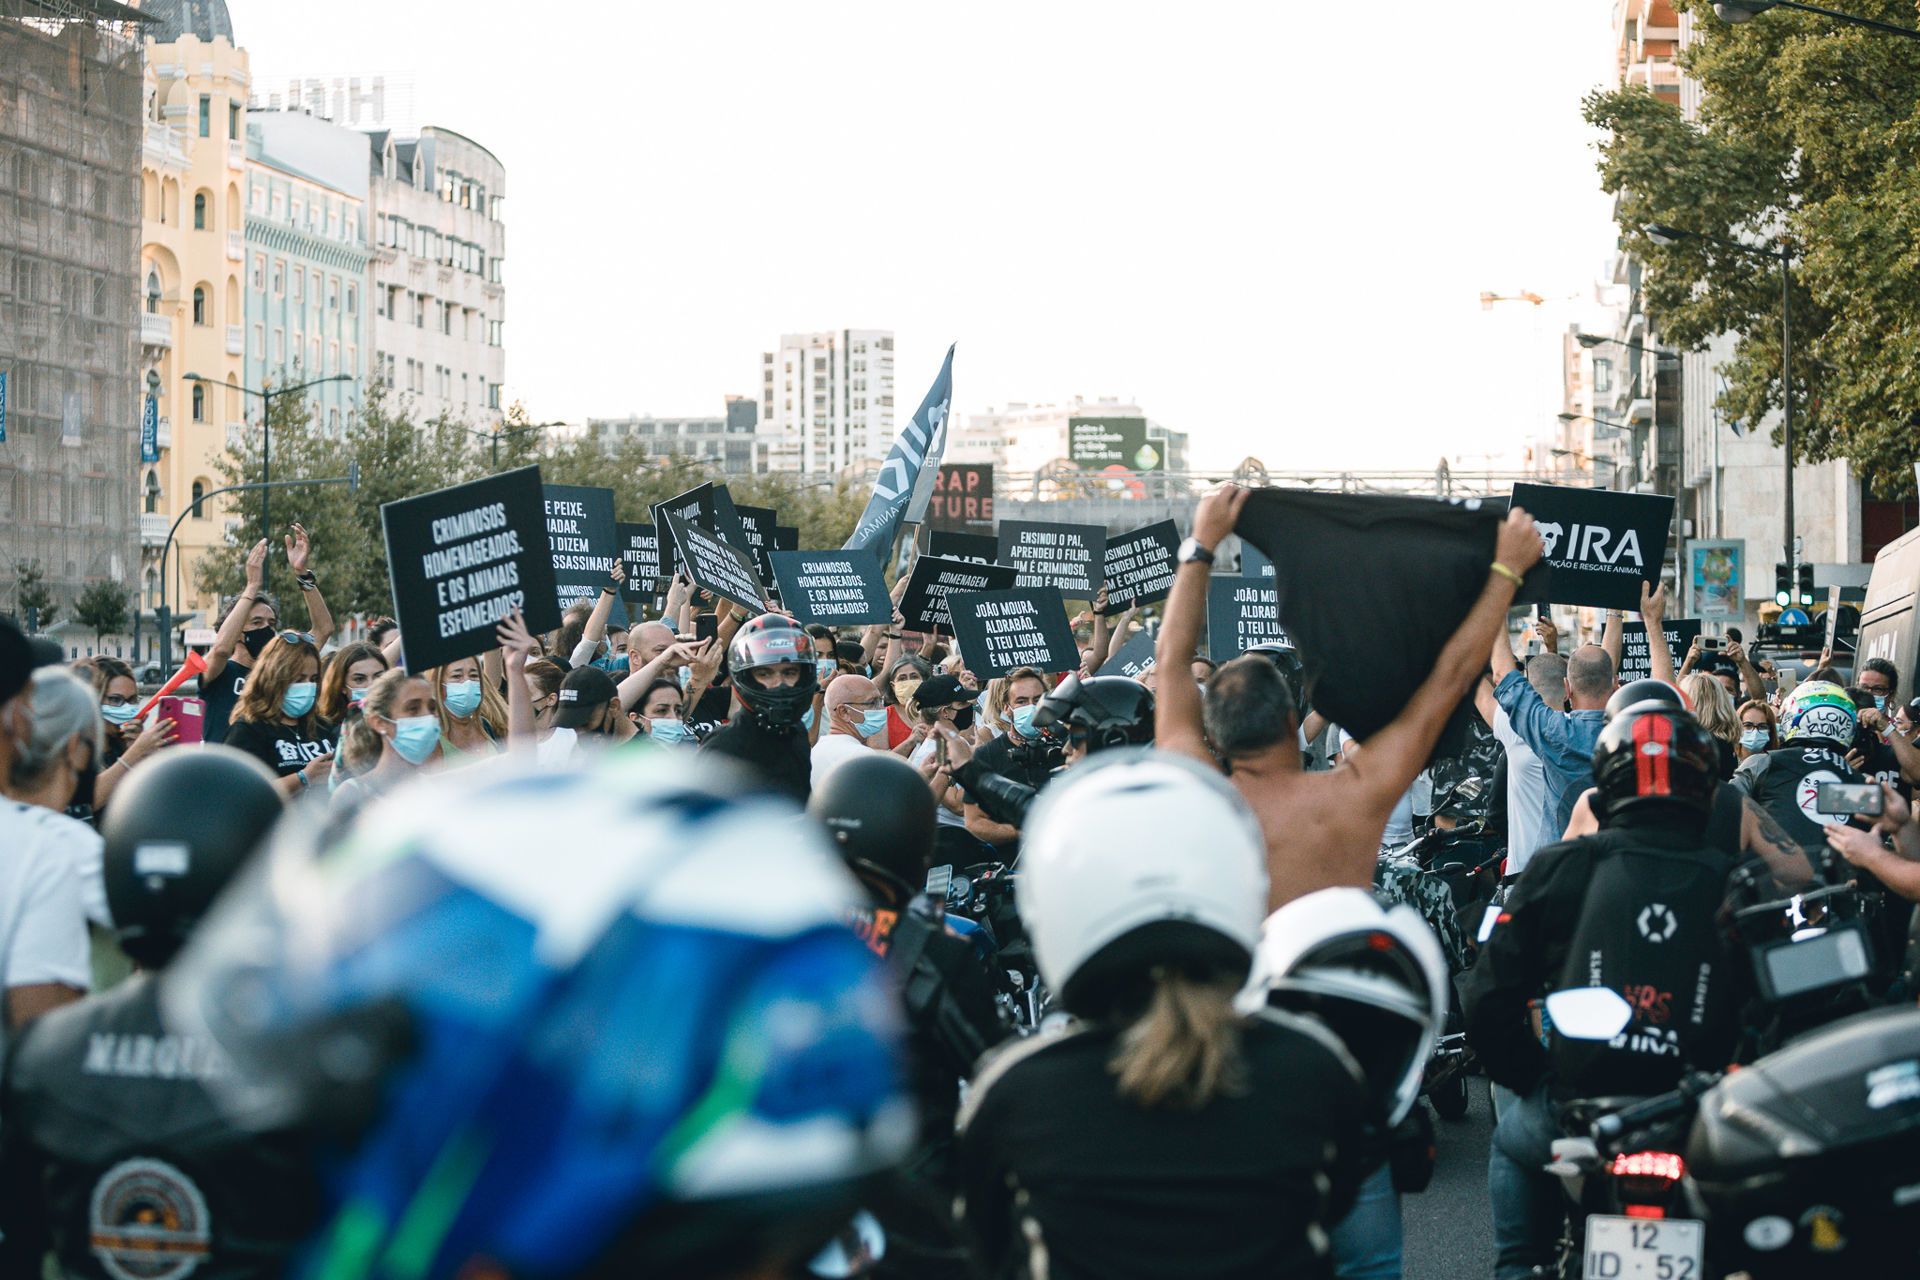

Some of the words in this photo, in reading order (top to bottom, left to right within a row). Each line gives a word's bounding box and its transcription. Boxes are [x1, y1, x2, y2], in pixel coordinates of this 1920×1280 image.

[554, 501, 586, 518] PEIXE,
[432, 502, 507, 545] CRIMINOSOS
[743, 517, 757, 532] PAI,
[557, 538, 589, 552] DIZEM
[1020, 531, 1057, 546] ENSINOU
[1059, 534, 1065, 546] O
[1067, 534, 1083, 548] PAI,
[1133, 540, 1140, 552] O
[1141, 536, 1159, 551] PAI,
[1566, 523, 1643, 566] IRA
[423, 530, 524, 579] HOMENAGEADOS.
[1010, 545, 1054, 560] APRENDEU
[1057, 548, 1063, 560] O
[1065, 549, 1092, 562] FILHO.
[1104, 557, 1136, 577] RENDEU
[1136, 555, 1144, 567] O
[1144, 546, 1172, 564] FILHO.
[552, 555, 613, 572] SSASSINAR!
[632, 565, 638, 577] A
[802, 562, 853, 574] CRIMINOSOS
[1029, 560, 1036, 573] É
[1037, 560, 1087, 577] CRIMINOSO,
[1573, 561, 1578, 569] E
[1579, 562, 1611, 572] RESGATE
[1612, 566, 1642, 575] ANIMAL
[797, 575, 866, 588] HOMENAGEADOS.
[938, 571, 989, 588] HOMENAGEM
[1015, 575, 1043, 588] OUTRO
[1053, 576, 1092, 591] ARGUIDO.
[1116, 574, 1124, 588] É
[1123, 562, 1173, 586] CRIMINOSO,
[437, 582, 448, 607] E
[448, 577, 467, 603] OS
[468, 561, 519, 598] ANIMAIS
[629, 579, 640, 591] DE
[808, 590, 815, 601] E
[815, 589, 828, 601] OS
[829, 589, 864, 601] ANIMAIS
[1108, 587, 1135, 605] OUTRO
[1135, 583, 1142, 597] É
[1234, 587, 1258, 603] JOÃO
[810, 602, 869, 615] ESFOMEADOS?
[928, 598, 934, 609] A
[975, 602, 999, 618] JOÃO
[1000, 600, 1038, 616] MOURA,
[920, 611, 932, 622] DE
[1241, 605, 1279, 619] ALDRAB
[985, 616, 1037, 634] ALDRABÃO.
[1238, 621, 1244, 634] O
[1247, 621, 1264, 635] TEU
[986, 637, 994, 651] O
[994, 635, 1013, 650] TEU
[1014, 632, 1046, 648] LUGAR
[1238, 636, 1244, 650] É
[1622, 632, 1644, 644] FILHO
[990, 653, 998, 668] É
[1000, 652, 1013, 667] NA
[1013, 648, 1052, 665] PRISÃO!
[1627, 645, 1647, 656] SABE
[1623, 658, 1633, 669] OU
[1635, 657, 1651, 669] COM
[1817, 711, 1851, 730] LOVE
[1631, 1222, 1658, 1250] 12
[1590, 1252, 1621, 1279] ID
[1657, 1255, 1694, 1280] 52
